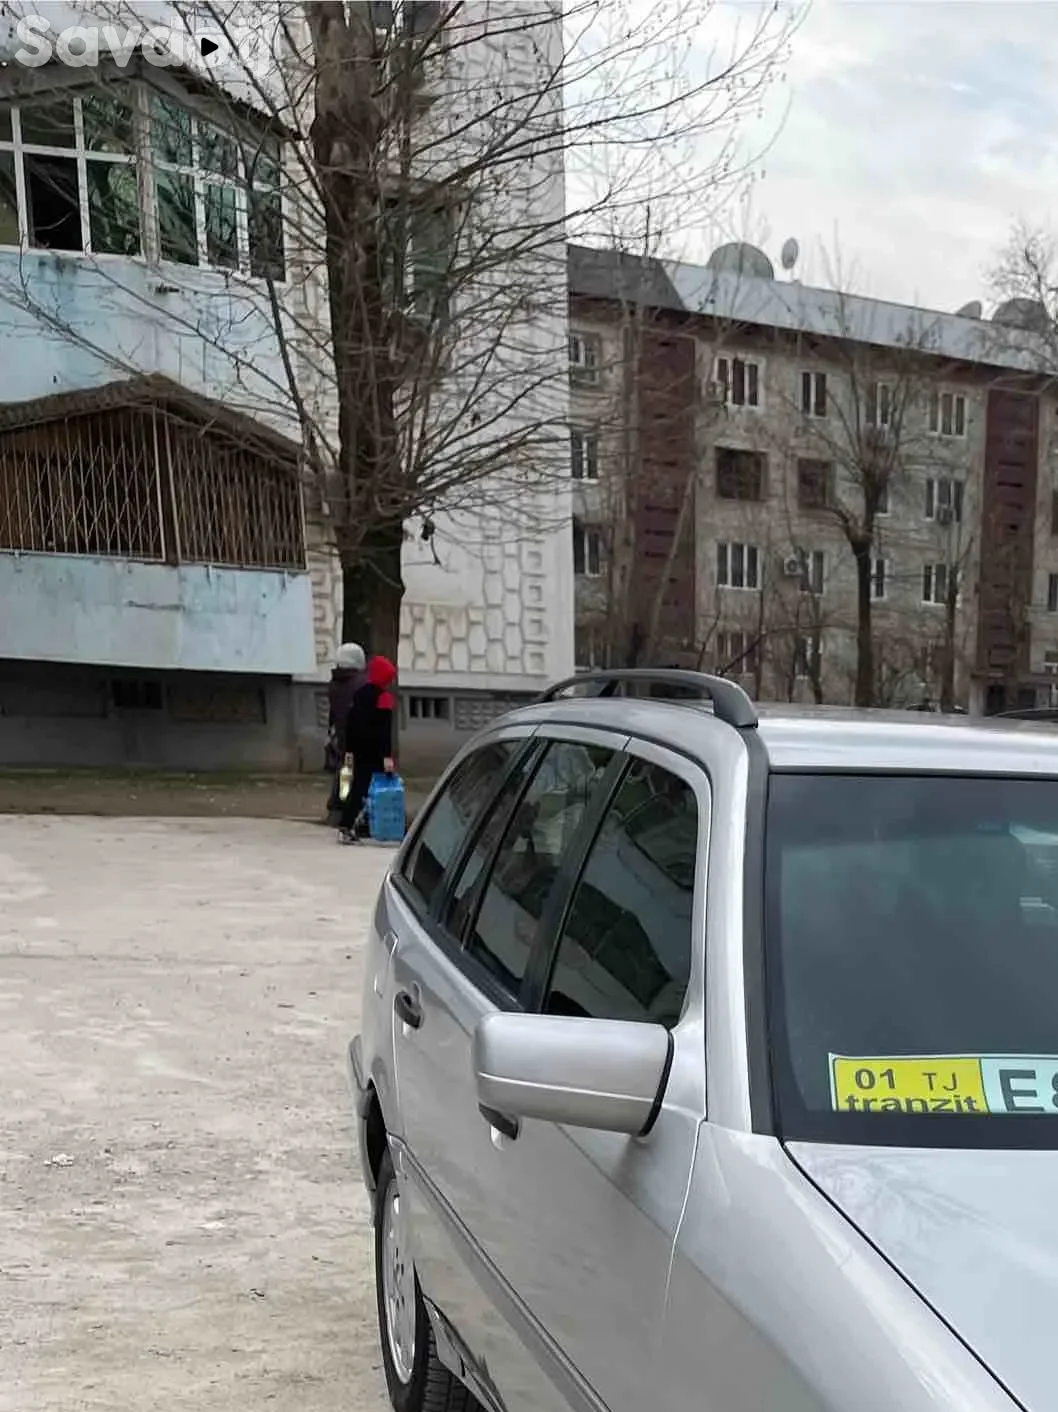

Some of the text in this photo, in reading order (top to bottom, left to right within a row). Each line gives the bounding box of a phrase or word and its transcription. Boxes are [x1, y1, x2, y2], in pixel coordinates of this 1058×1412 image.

[855, 1068, 958, 1091] 01 TJ
[846, 1094, 981, 1113] tranzit
